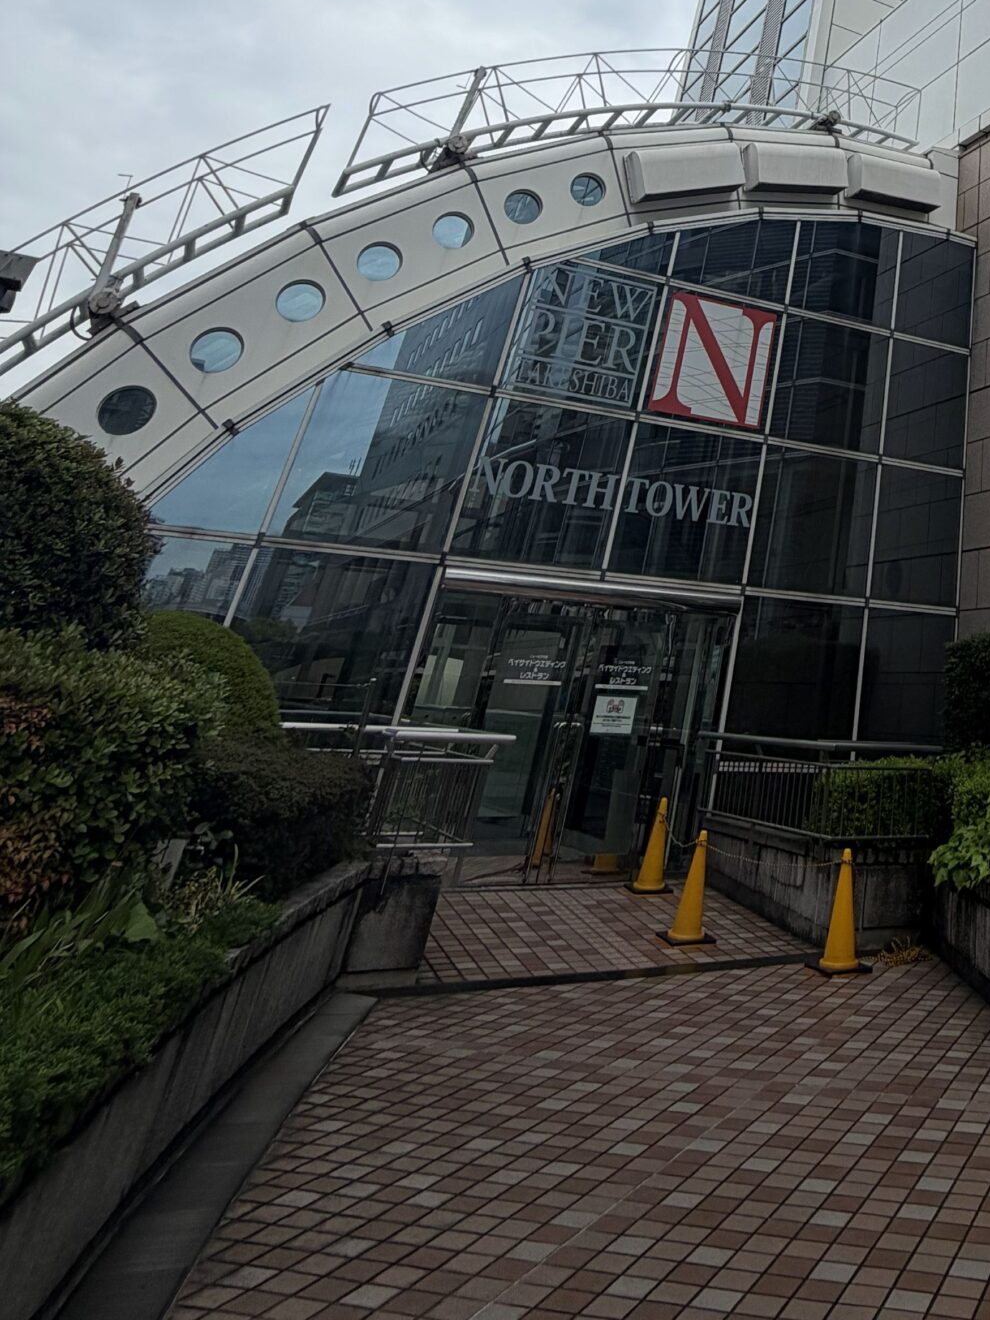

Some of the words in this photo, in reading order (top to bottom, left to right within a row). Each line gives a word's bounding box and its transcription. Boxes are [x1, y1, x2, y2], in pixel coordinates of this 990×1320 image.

[533, 268, 654, 321] NEW
[525, 309, 636, 374] PIER
[649, 290, 777, 429] N
[468, 455, 621, 511] NORTH
[624, 476, 754, 528] TOWER
